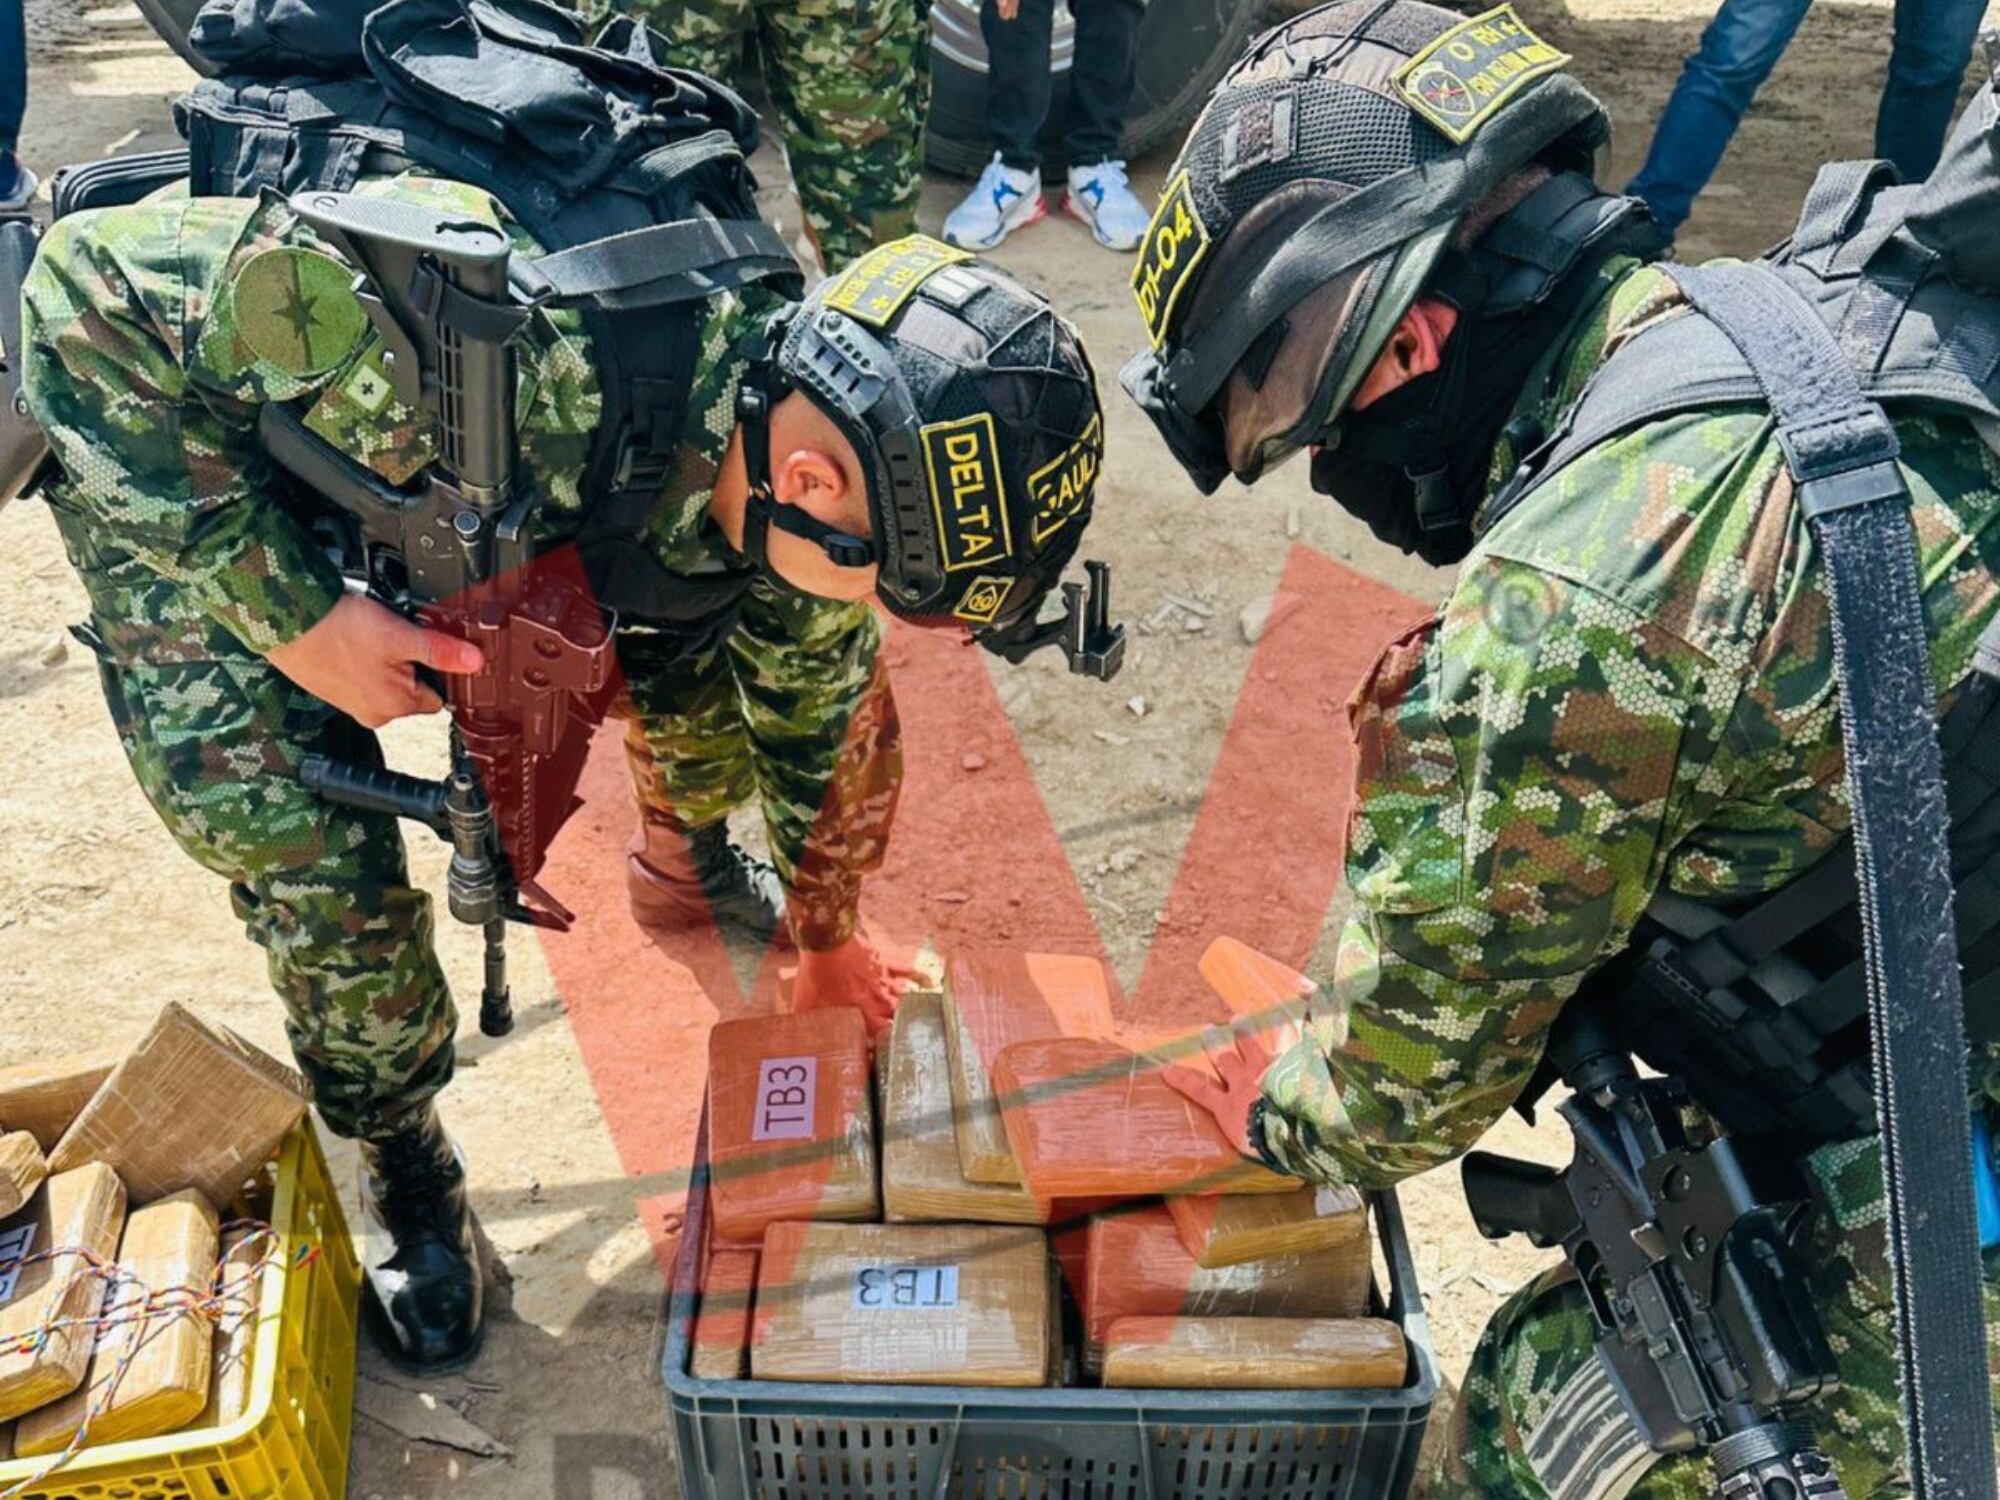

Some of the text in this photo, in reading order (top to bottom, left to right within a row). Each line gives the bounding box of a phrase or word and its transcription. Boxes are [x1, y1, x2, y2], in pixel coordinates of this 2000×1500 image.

[945, 432, 993, 557] DELTA
[764, 1064, 808, 1132] TB3
[858, 1267, 955, 1307] TB3
